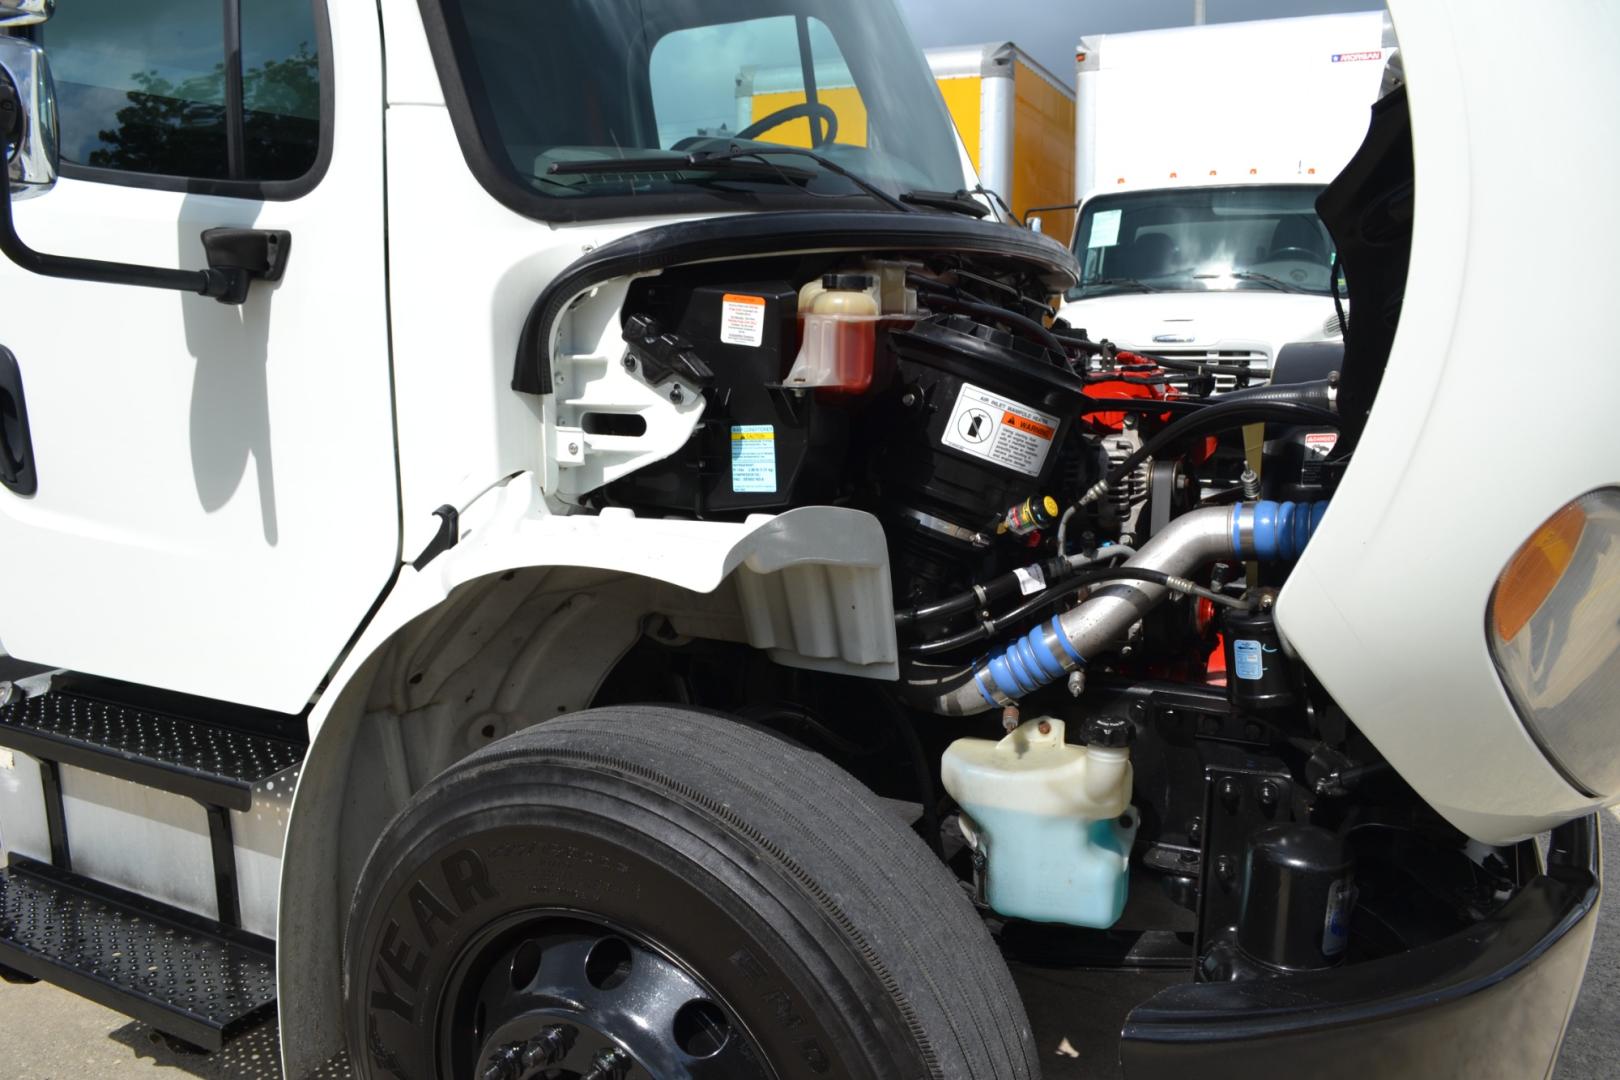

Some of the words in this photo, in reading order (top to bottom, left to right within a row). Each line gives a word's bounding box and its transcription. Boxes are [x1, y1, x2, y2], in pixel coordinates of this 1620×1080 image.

[1340, 52, 1380, 62] MORGAN
[990, 399, 1005, 408] INLET
[1019, 420, 1050, 438] WARNING
[370, 848, 500, 1024] YEAR
